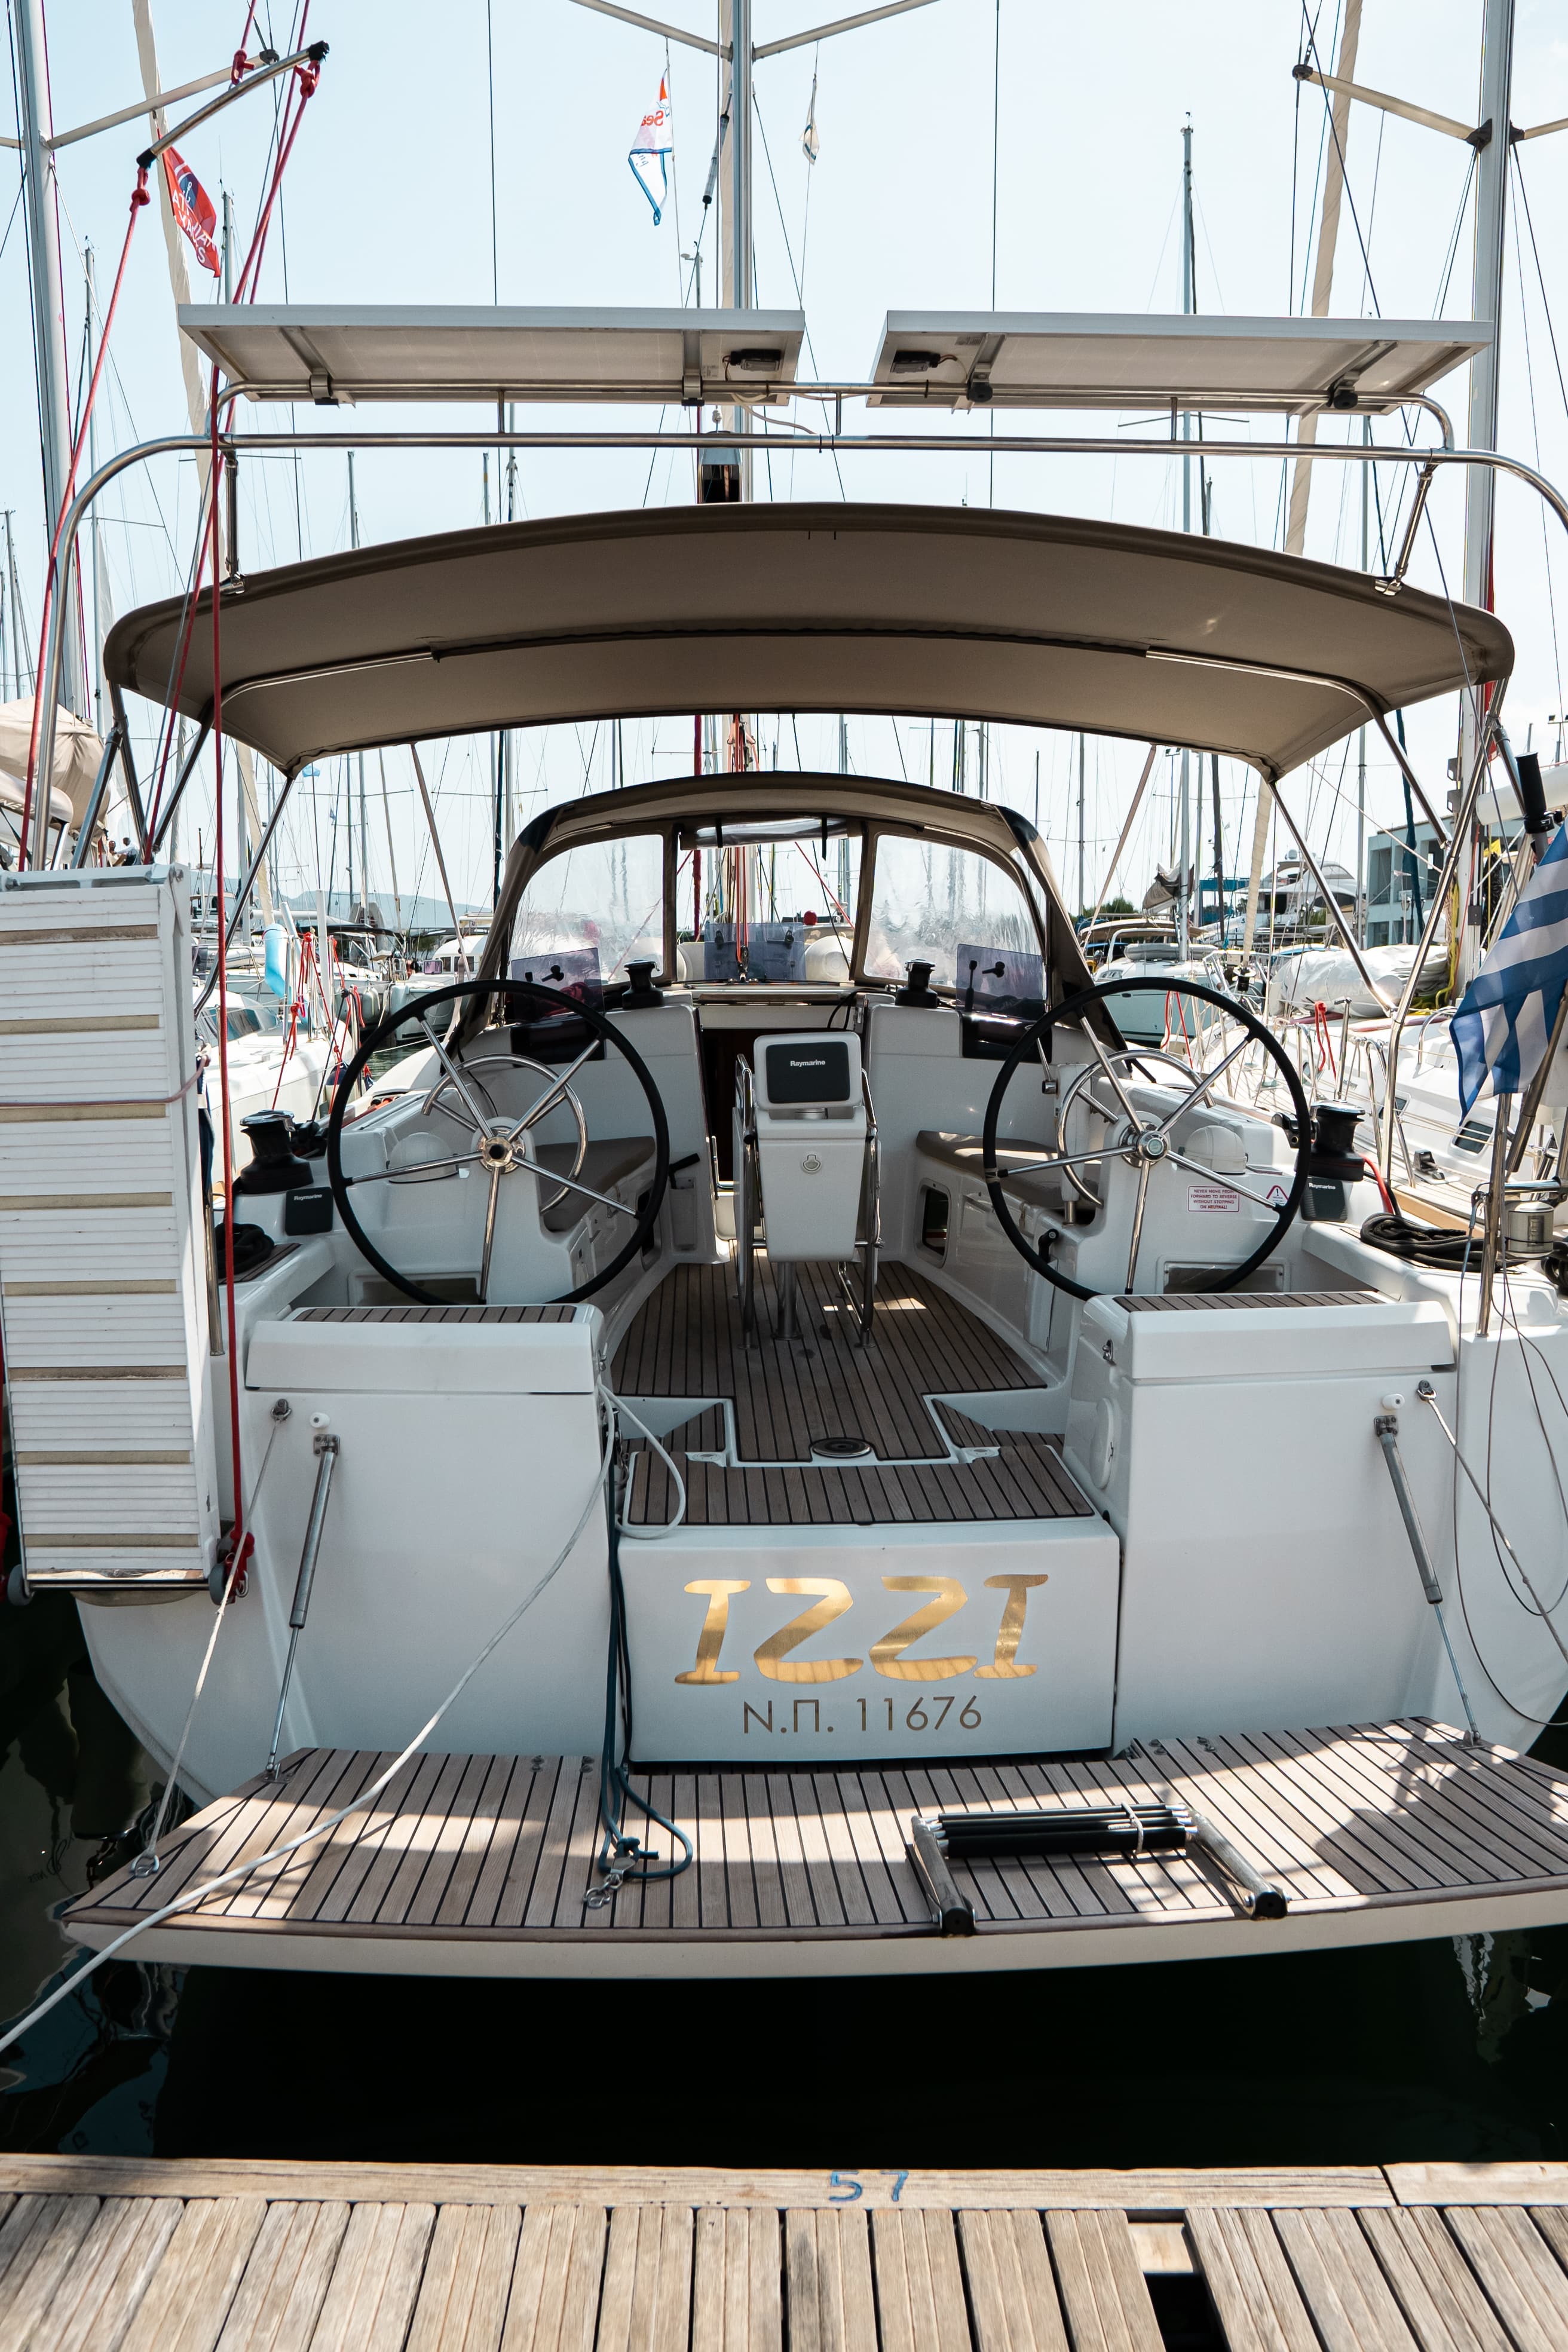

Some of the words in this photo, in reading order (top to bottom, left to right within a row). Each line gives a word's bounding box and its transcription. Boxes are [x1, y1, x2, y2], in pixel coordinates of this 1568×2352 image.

[790, 1059, 826, 1067] Raymarine
[674, 1573, 1049, 1685] IZZI
[856, 1695, 982, 1732] 11676
